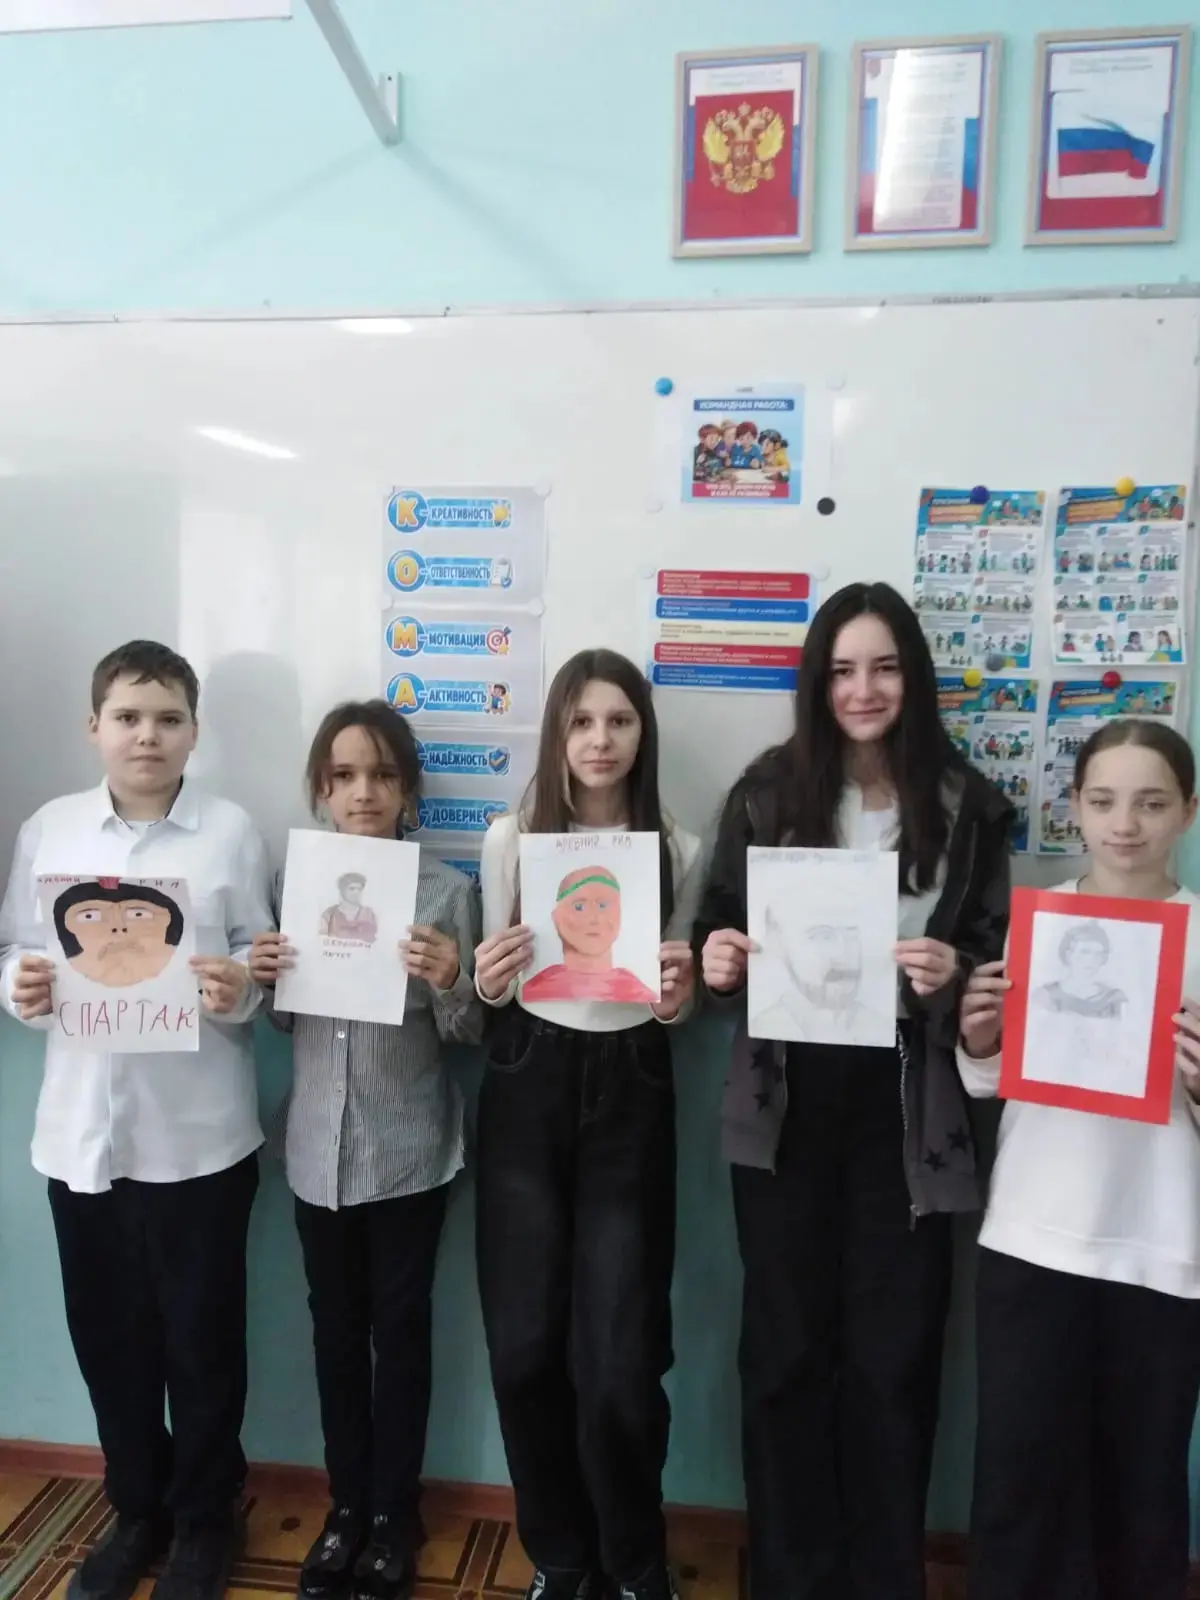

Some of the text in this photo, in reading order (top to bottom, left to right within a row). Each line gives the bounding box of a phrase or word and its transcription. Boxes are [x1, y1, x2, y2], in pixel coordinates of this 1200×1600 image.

[431, 507, 493, 521] КРЕАТИВНОСТЬ
[430, 566, 491, 579] ОТВЕТСТВЕННОСТЬ
[429, 633, 486, 648] МОТИВАЦИЯ
[428, 689, 487, 703] АКТИВНОСТЬ
[428, 749, 488, 765] НАДЁЖНОСТЬ
[431, 807, 484, 823] ДОВЕРИЕ
[59, 999, 195, 1037] СПАРТАК
